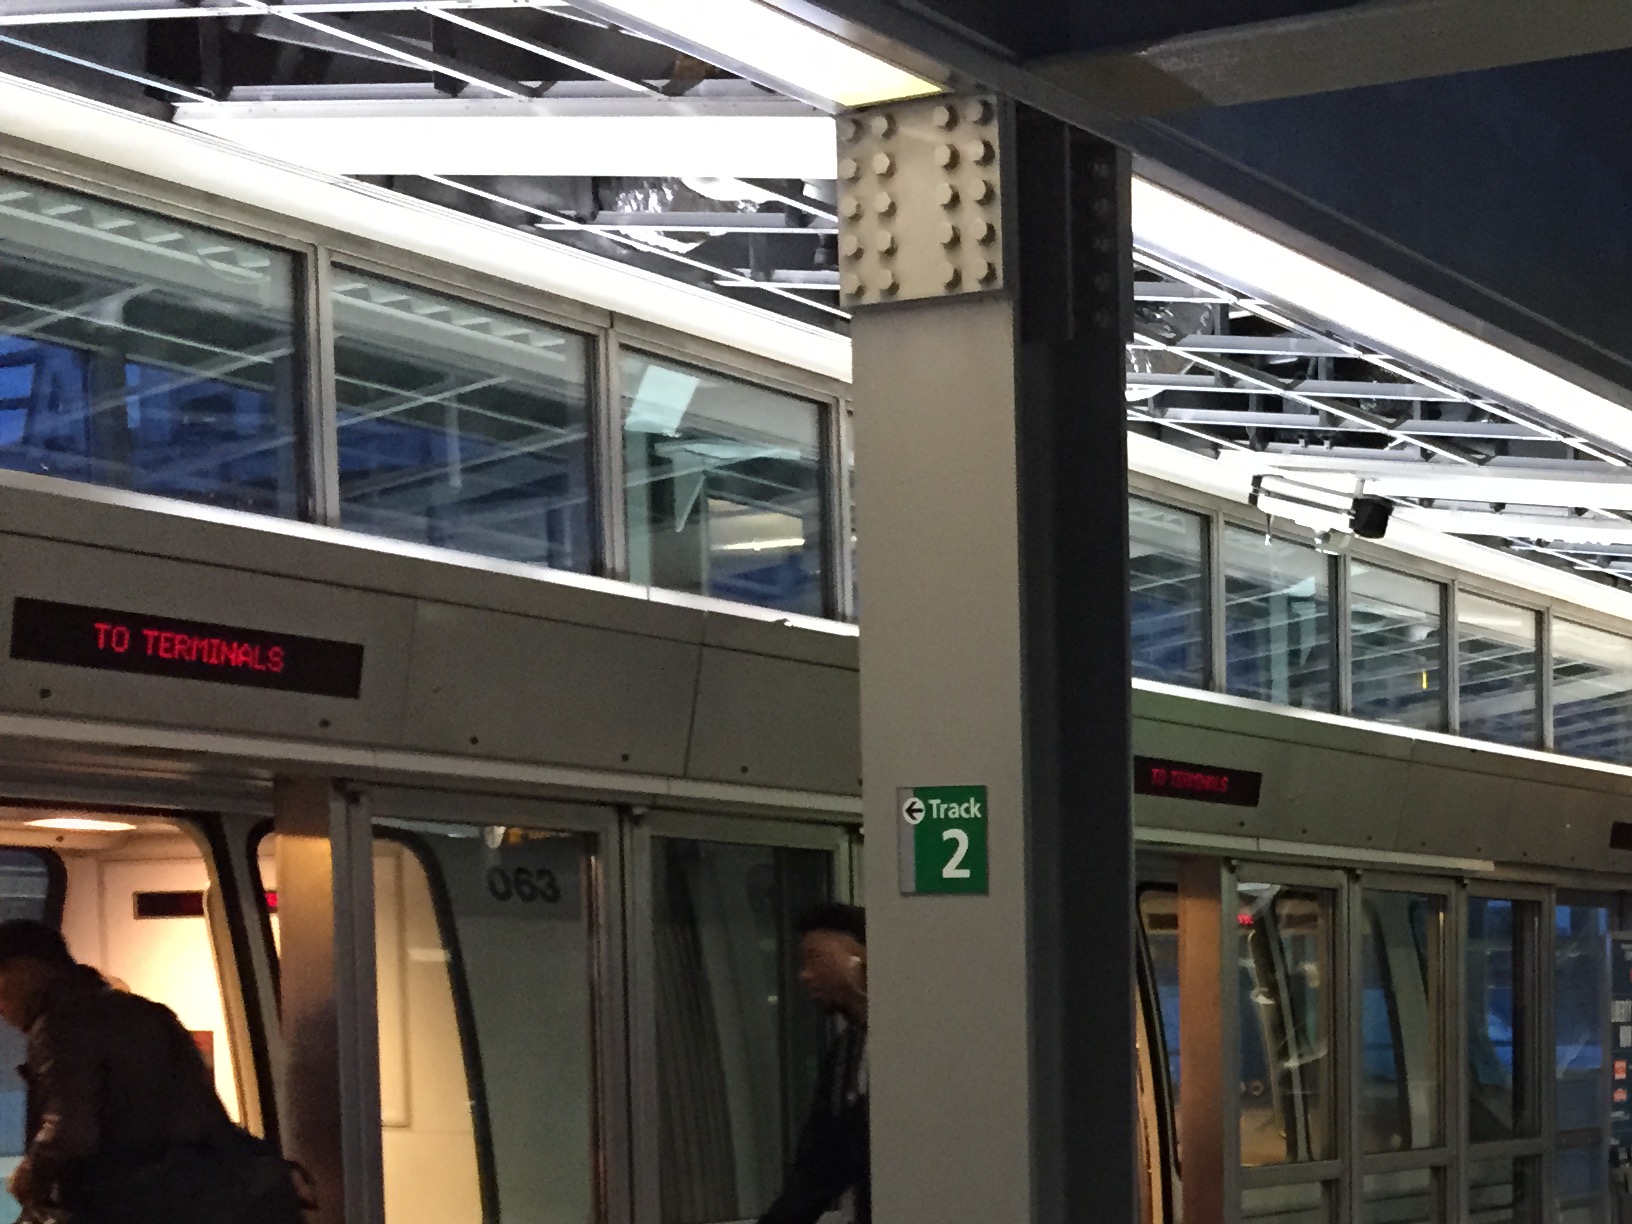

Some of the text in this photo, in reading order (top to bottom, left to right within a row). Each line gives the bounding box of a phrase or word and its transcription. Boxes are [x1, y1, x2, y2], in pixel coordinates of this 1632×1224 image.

[94, 622, 286, 673] TO TERMINALS
[928, 796, 982, 819] Track
[942, 828, 971, 879] 2
[486, 866, 562, 903] 063
